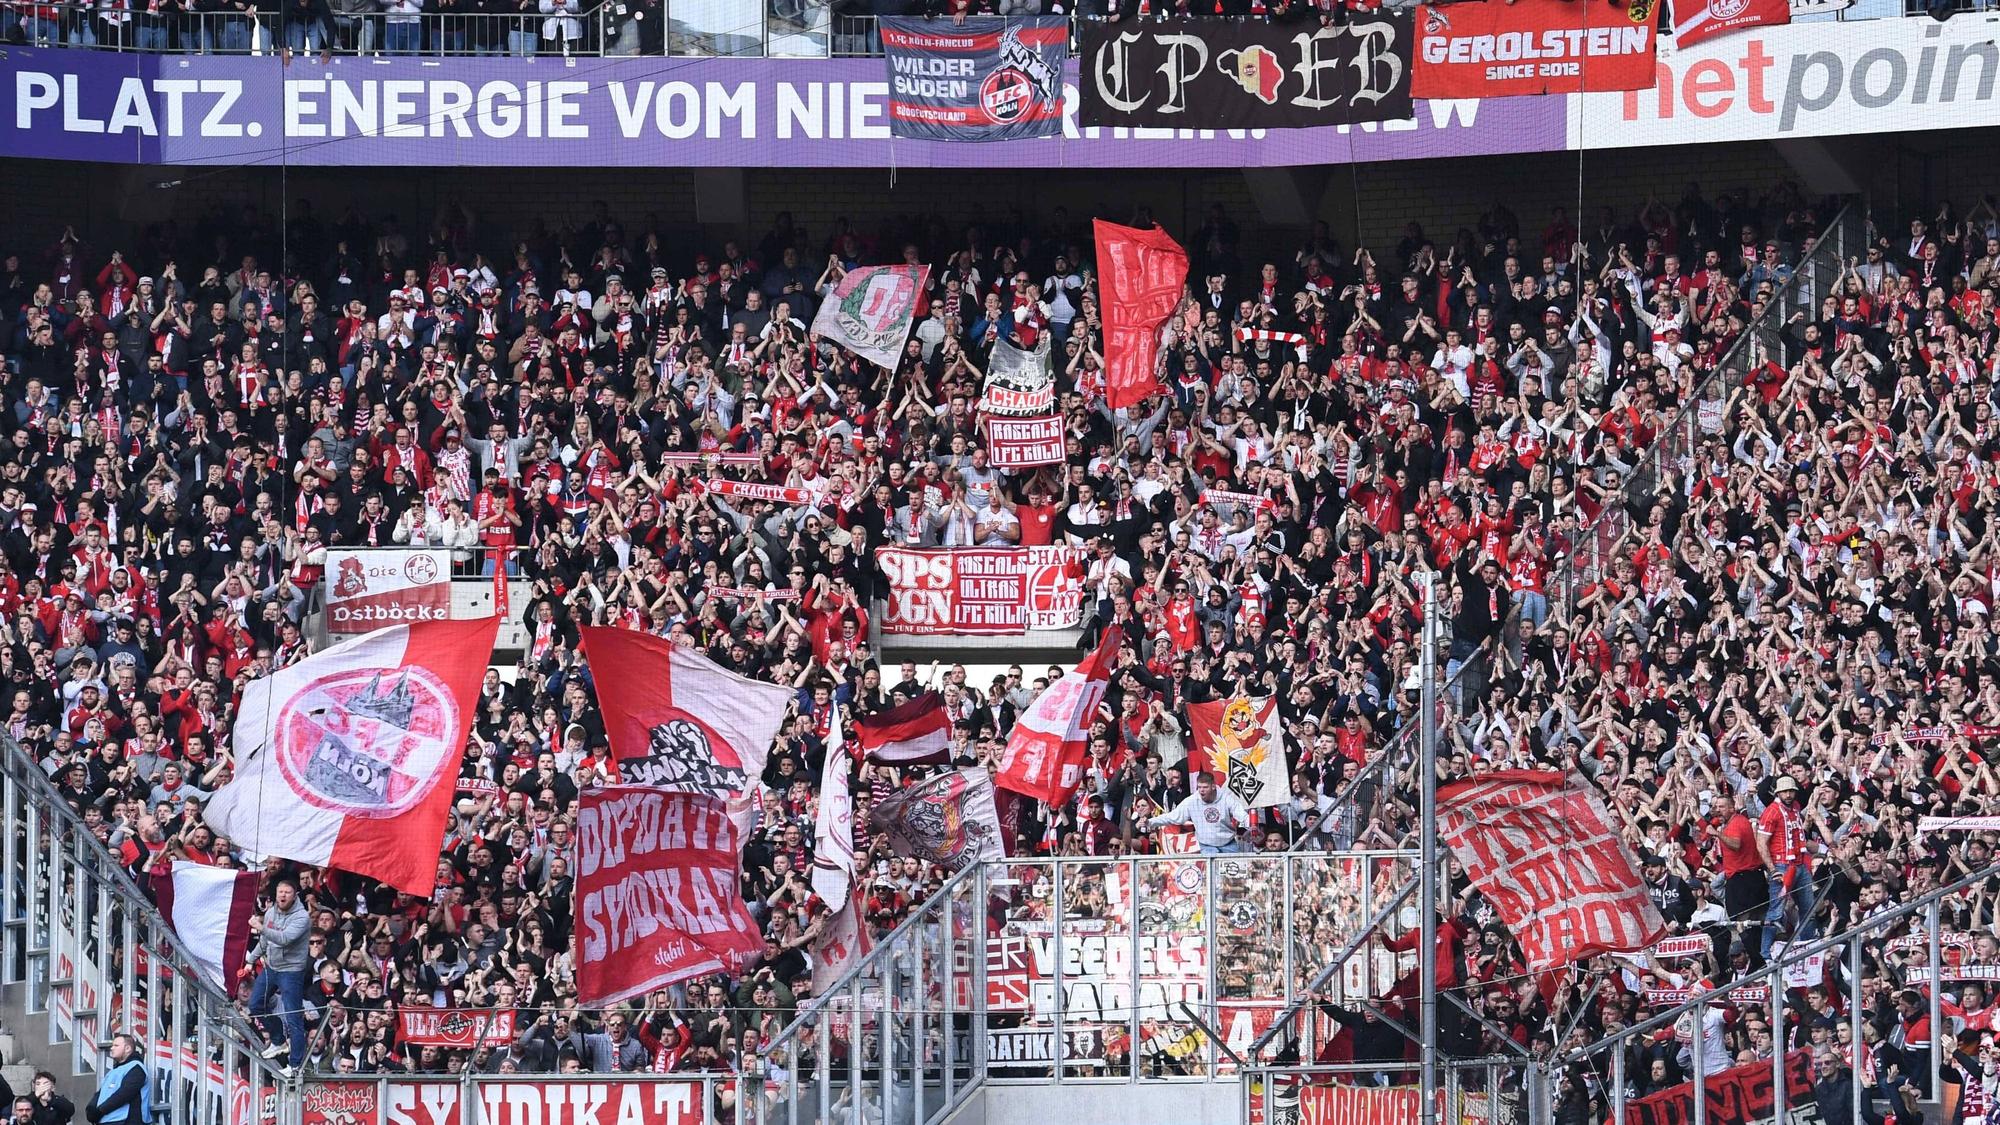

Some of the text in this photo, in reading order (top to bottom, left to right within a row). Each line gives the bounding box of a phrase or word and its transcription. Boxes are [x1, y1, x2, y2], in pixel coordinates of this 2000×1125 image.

[1704, 15, 1762, 33] EAST BELGIUM
[1422, 26, 1649, 64] GEROLSTEIN
[892, 55, 975, 77] WILDER
[1485, 62, 1580, 80] SINCE 2012
[894, 75, 968, 99] SÜDEN
[988, 86, 1023, 108] 1.FC
[15, 70, 263, 138] PLATZ.
[284, 80, 589, 139] ENERGIE
[607, 81, 758, 140] VOM
[995, 101, 1019, 117] KÖLN
[1022, 442, 1063, 462] KÖLN
[732, 483, 787, 500] CHAOTIX
[368, 566, 398, 577] Die
[879, 551, 953, 589] SPS
[960, 579, 1020, 599] ULTRAS
[333, 601, 447, 622] Ostböcke
[1664, 888, 1680, 900] 96
[654, 937, 686, 969] stabil
